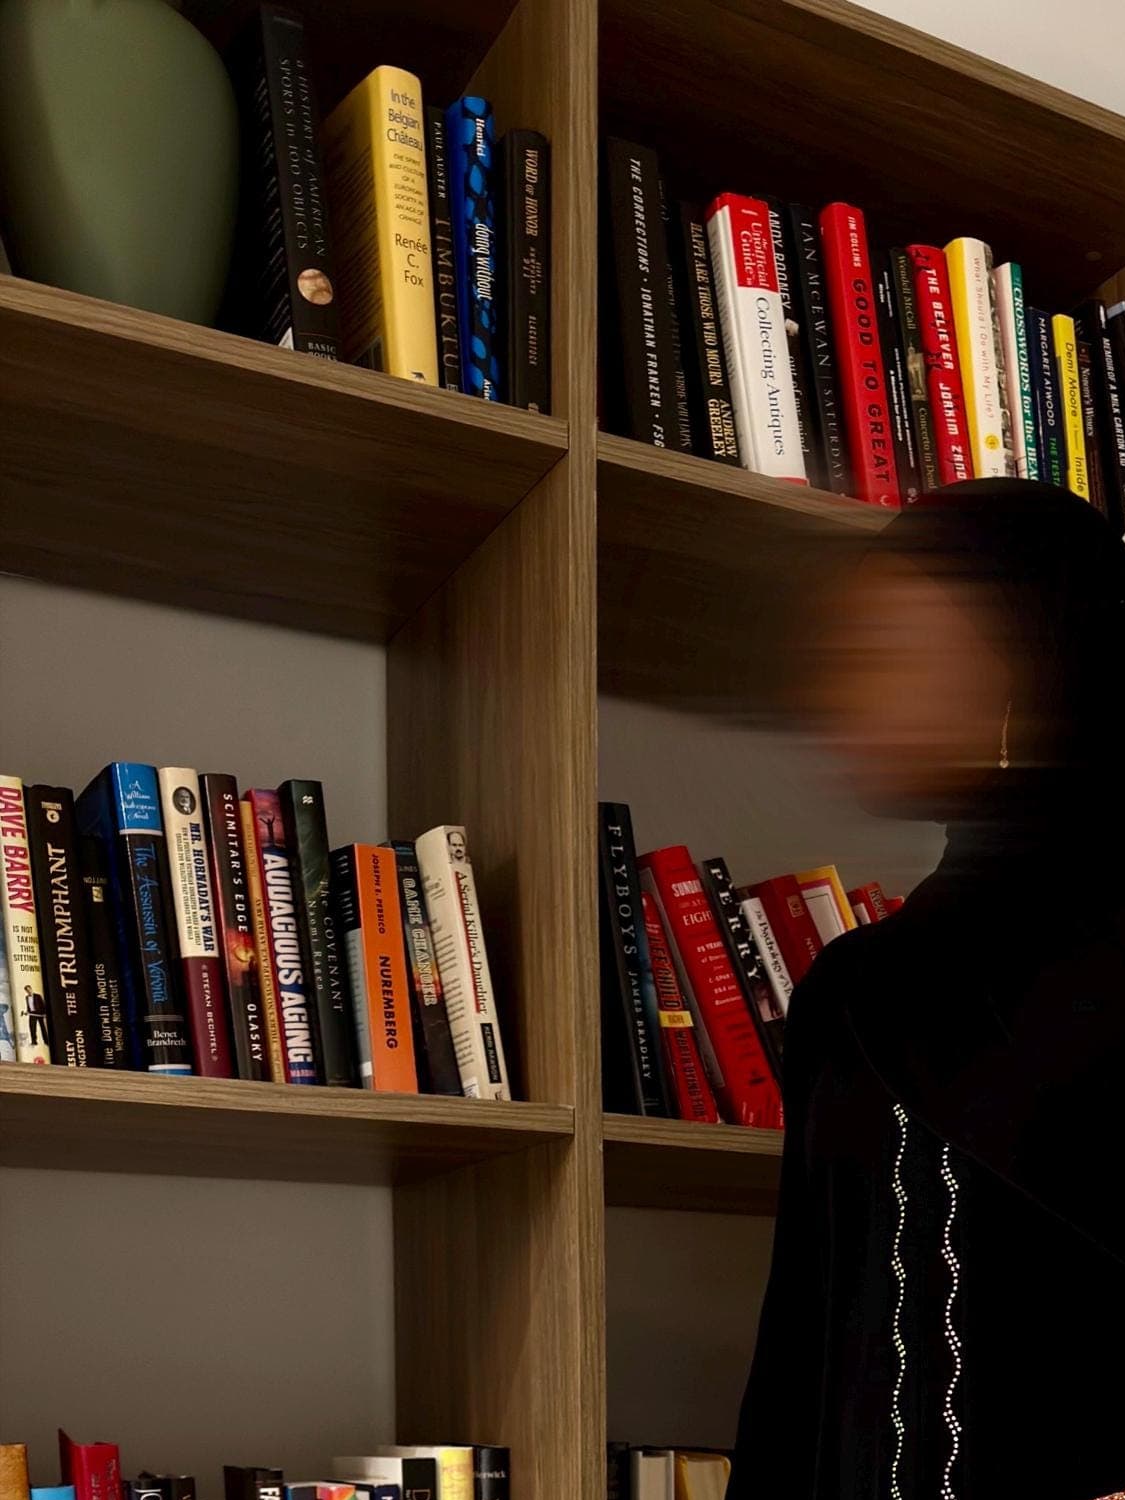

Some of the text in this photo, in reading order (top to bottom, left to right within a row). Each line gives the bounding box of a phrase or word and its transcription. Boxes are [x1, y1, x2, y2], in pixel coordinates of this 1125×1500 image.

[387, 128, 424, 152] Château
[388, 108, 421, 130] Belgian
[279, 57, 294, 114] SPORTS
[292, 184, 307, 249] OBJECTS
[434, 121, 446, 199] PAUL AUSTER
[525, 149, 539, 184] WORD
[395, 233, 428, 254] Renée
[524, 197, 539, 237] HONOR
[629, 158, 649, 273] THE CORRECTIONS
[800, 223, 817, 262] IAN
[404, 269, 425, 287] Fox
[407, 253, 419, 269] C.
[471, 222, 494, 301] doing without
[750, 223, 768, 289] Unofficial
[849, 236, 861, 268] COLLINS
[897, 255, 910, 293] Wendell
[434, 215, 459, 371] TIMBUKTU
[690, 222, 723, 386] HAPPY ARE THOSE WHO MOURN
[926, 269, 955, 369] THE BELIEVER
[307, 342, 337, 354] BASIC
[640, 288, 662, 408] JONATHAN FRANZEN
[756, 296, 785, 456] Collecting Antiques
[1038, 318, 1056, 427] MARGARET ATWOOD
[853, 278, 890, 482] GOOD TO GREAT
[1065, 343, 1080, 418] Demi Moore
[708, 398, 726, 457] GREELEY
[719, 399, 737, 458] ANDREW
[823, 386, 844, 480] SATURDAY
[1074, 456, 1087, 493] Inside
[0, 787, 34, 913] DAVE BARRY
[134, 845, 156, 868] The
[222, 793, 249, 933] SCIMITAR'S EDGE
[371, 854, 382, 887] JOSEPH
[139, 875, 160, 935] Assassin
[190, 822, 215, 952] MR. HORNADAY'S WAR
[376, 898, 386, 934] PERSICO
[402, 877, 424, 924] GAME
[459, 883, 473, 918] Serial
[608, 825, 638, 955] FLYBOYS
[47, 842, 78, 1016] THE TRIUMPHANT
[306, 900, 325, 991] Naomi Ragen
[465, 920, 482, 959] Killer's
[709, 866, 761, 980] PERRY
[13, 954, 38, 962] SITTING
[95, 963, 107, 998] Awards
[148, 957, 168, 1004] Verona
[262, 852, 304, 985] AUDACIOUS
[284, 991, 315, 1063] AGING
[322, 917, 345, 1013] COVENANT
[412, 928, 438, 1006] CHANGER
[471, 960, 490, 1014] Daughter
[99, 1001, 112, 1041] Darwin
[201, 971, 218, 1054] STEFAN BECHTEL
[246, 1003, 263, 1062] OLASKY
[378, 956, 399, 1049] NUREMBERG
[628, 970, 651, 1080] JAMES BRADLEY
[154, 1030, 178, 1039] Benet
